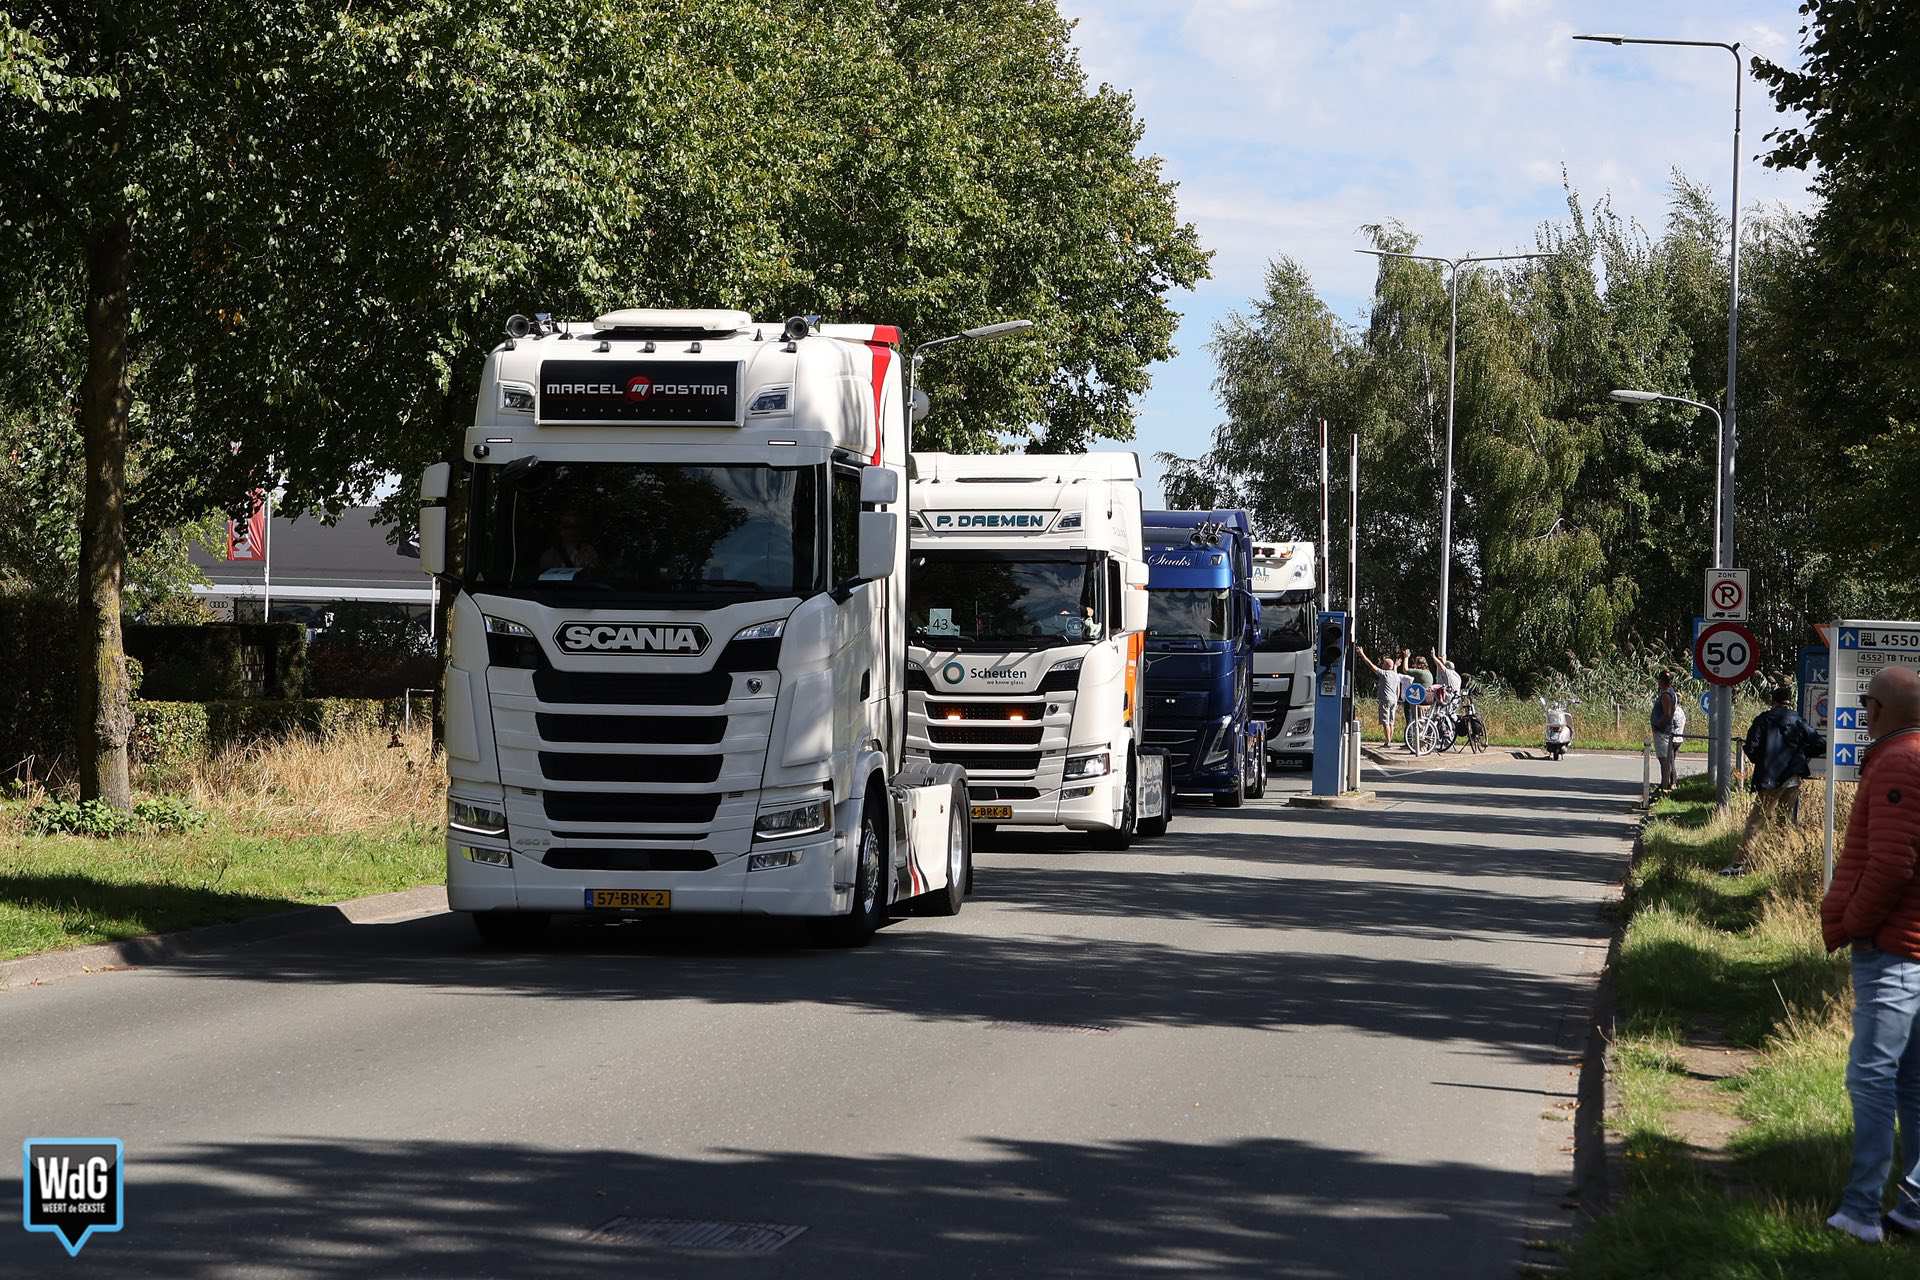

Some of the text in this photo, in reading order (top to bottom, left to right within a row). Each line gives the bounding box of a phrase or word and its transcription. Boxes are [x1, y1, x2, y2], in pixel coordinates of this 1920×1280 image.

[547, 384, 624, 395] MARCEL
[653, 384, 728, 395] POSTMA
[936, 515, 1043, 527] P. DAEMEN
[1253, 567, 1270, 577] AL
[932, 618, 948, 630] 43
[564, 626, 700, 650] SCANIA
[1880, 634, 1919, 646] 4550
[1706, 642, 1747, 666] 50
[1860, 654, 1882, 662] 4552
[970, 667, 1027, 679] Scheuten
[971, 807, 1009, 816] 4-BRK-8
